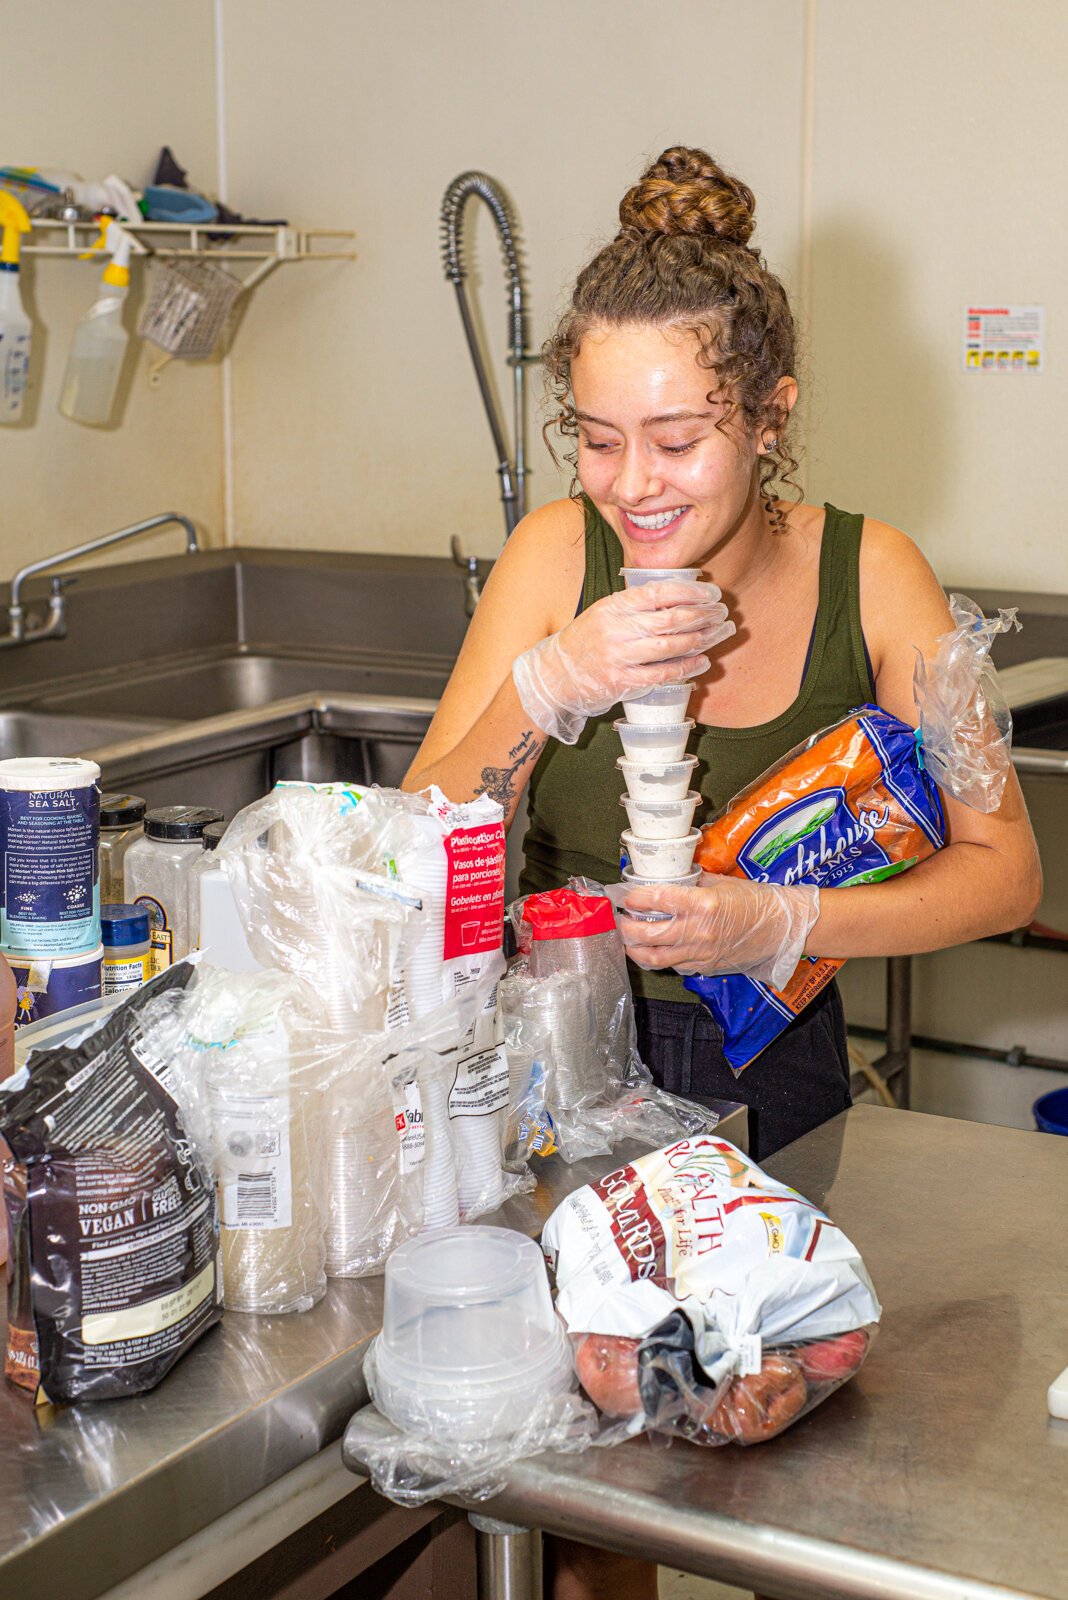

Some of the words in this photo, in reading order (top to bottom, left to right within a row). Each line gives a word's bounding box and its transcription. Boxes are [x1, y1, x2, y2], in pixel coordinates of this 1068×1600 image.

[29, 791, 74, 799] NATURAL
[53, 799, 75, 807] SALT
[453, 860, 474, 870] Vasos
[475, 857, 484, 867] de
[808, 847, 862, 884] RMS
[452, 873, 468, 884] para
[470, 868, 500, 882] porciones
[831, 864, 854, 879] 1915
[451, 895, 481, 906] Gobelets
[483, 893, 491, 901] en
[153, 932, 167, 941] EAST
[792, 983, 811, 1006] PRODUCT
[809, 976, 816, 985] OF
[815, 963, 830, 977] U.S.A.
[795, 997, 807, 1010] KEEP
[806, 966, 838, 999] REFRIGERATED
[79, 1197, 136, 1215] NON-GMO
[79, 1209, 135, 1235] VEGAN
[92, 1241, 108, 1249] Find
